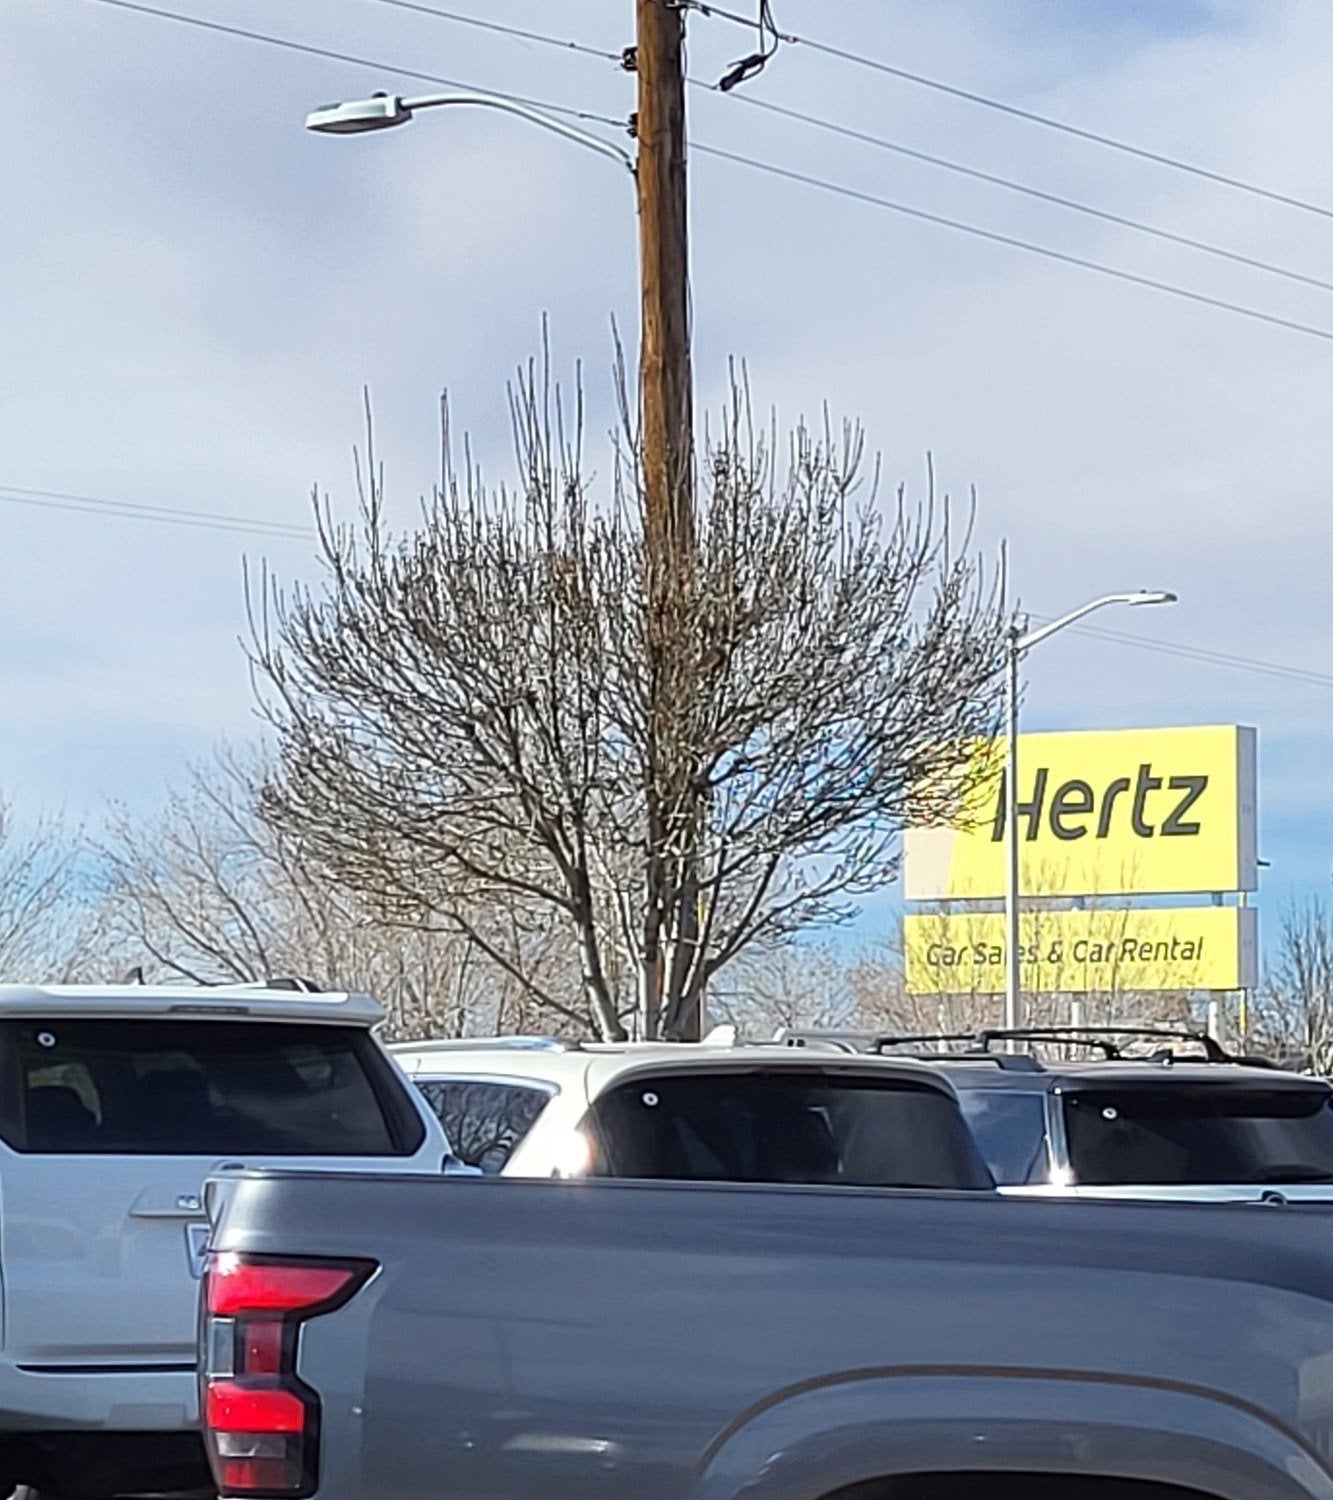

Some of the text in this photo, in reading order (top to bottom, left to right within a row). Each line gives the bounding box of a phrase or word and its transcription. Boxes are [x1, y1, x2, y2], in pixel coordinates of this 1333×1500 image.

[991, 763, 1209, 843] Hertz
[926, 943, 968, 967] Car
[1047, 940, 1063, 965] &
[1073, 939, 1115, 963] Car
[1119, 935, 1204, 963] Rental
